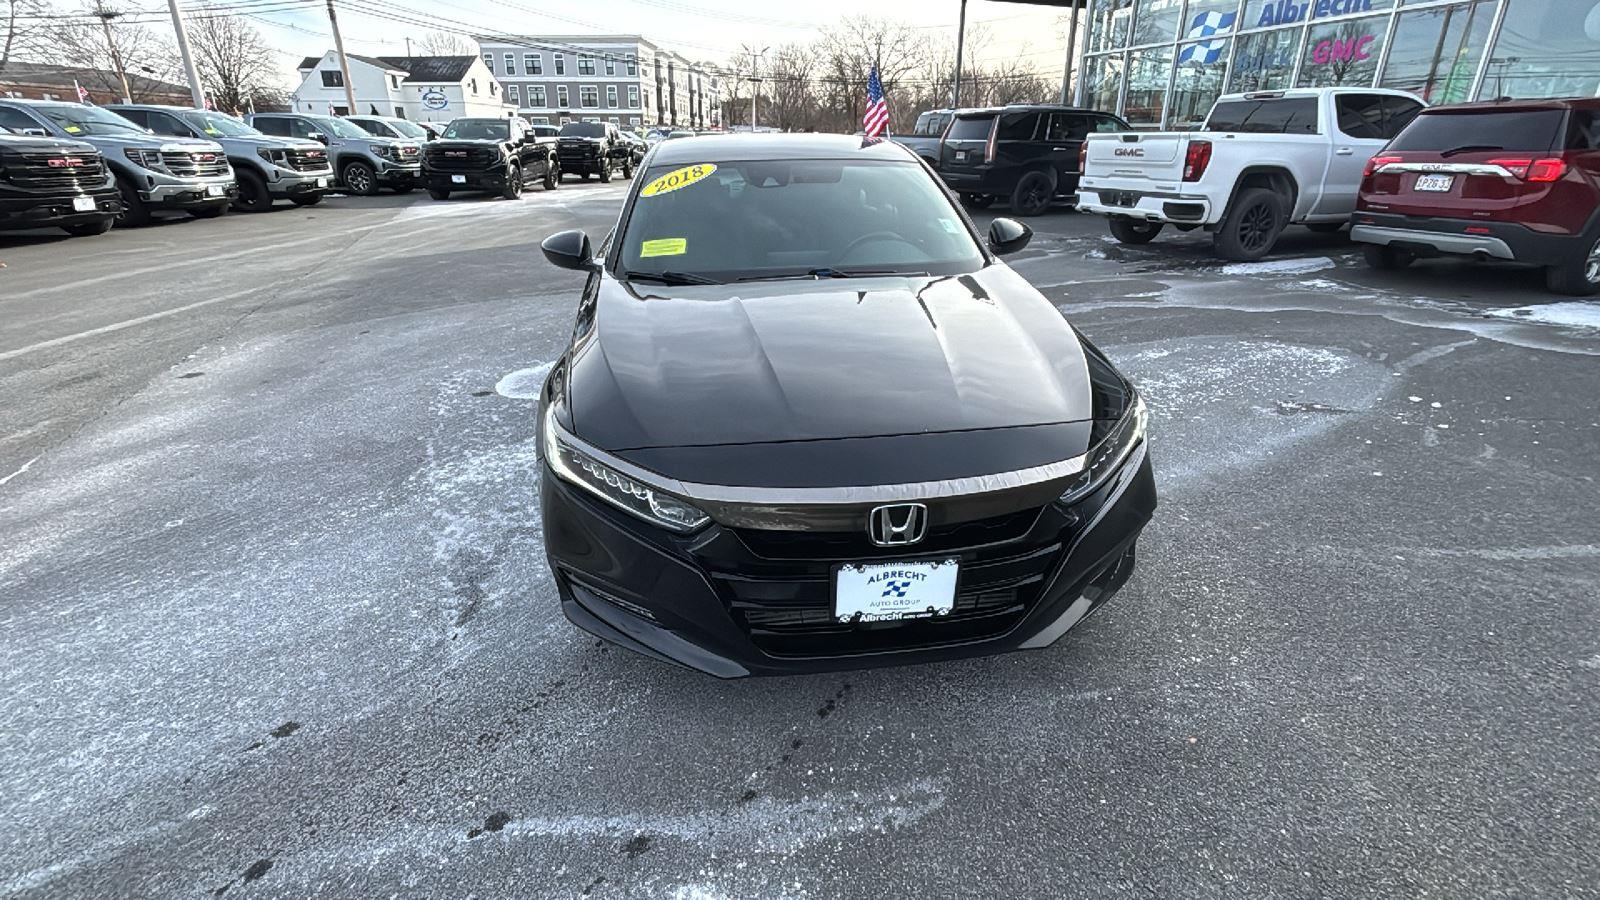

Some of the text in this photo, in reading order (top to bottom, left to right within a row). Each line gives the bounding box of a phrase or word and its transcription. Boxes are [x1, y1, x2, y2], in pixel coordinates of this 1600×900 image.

[1312, 34, 1375, 64] GMC
[1114, 148, 1144, 157] GMC
[655, 166, 704, 192] 2018
[867, 570, 927, 584] ALBRECHT
[859, 612, 903, 623] Albrecht
